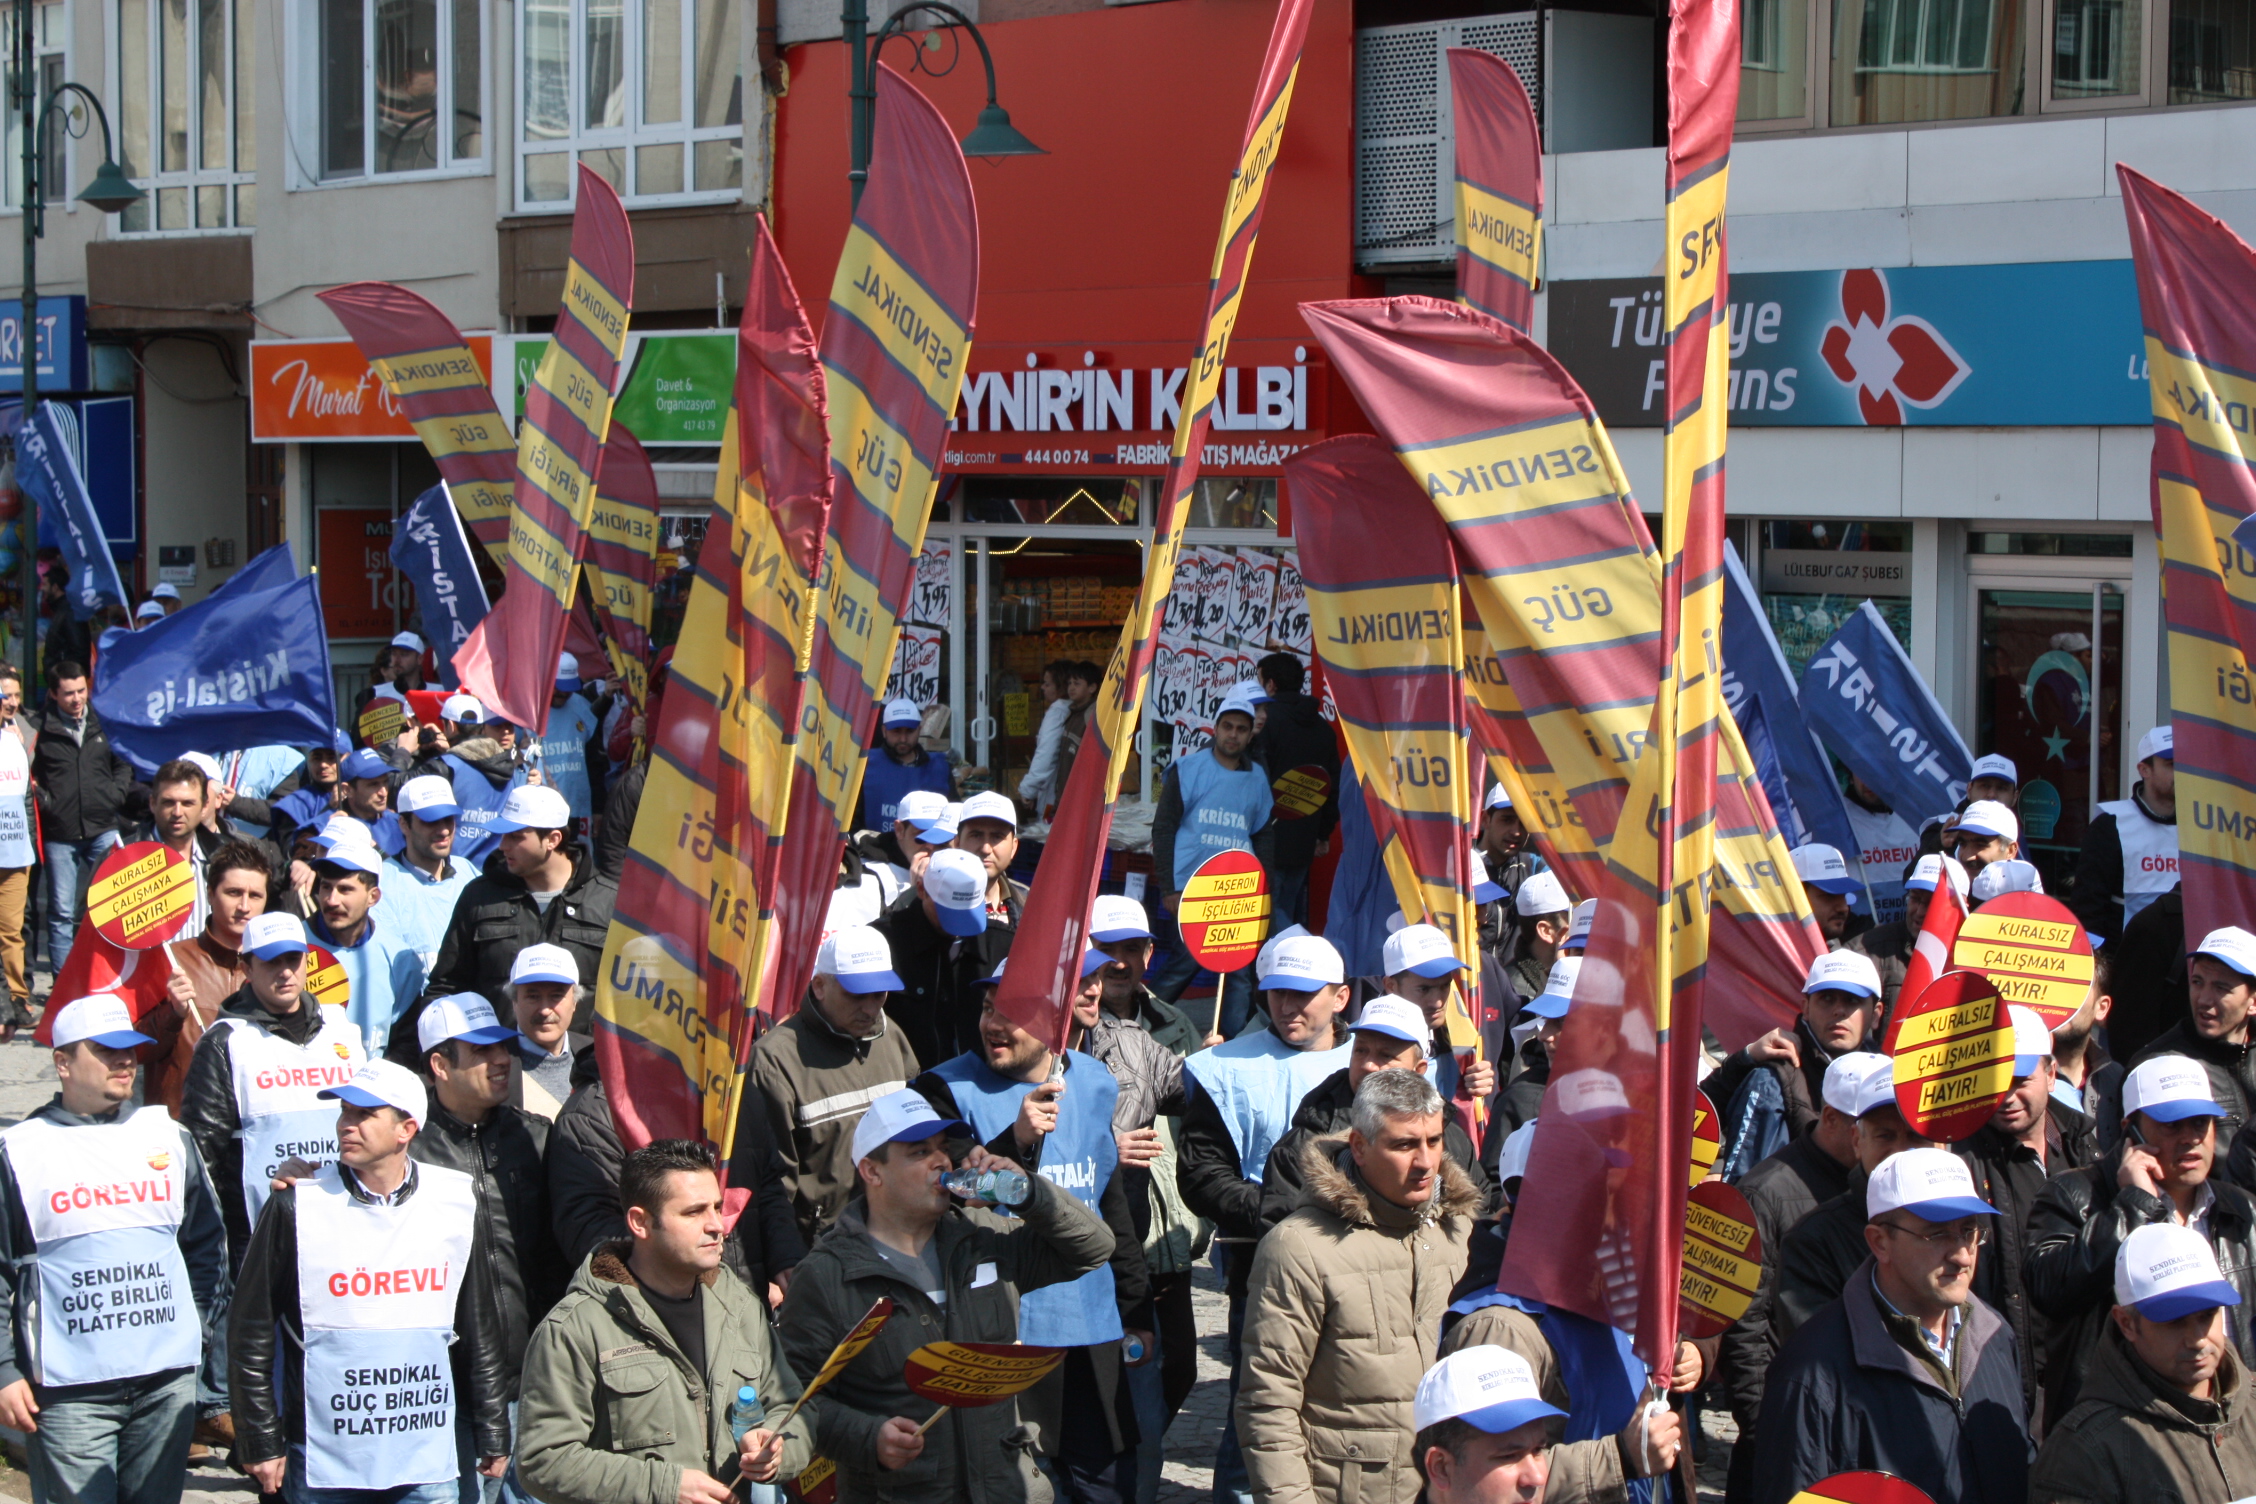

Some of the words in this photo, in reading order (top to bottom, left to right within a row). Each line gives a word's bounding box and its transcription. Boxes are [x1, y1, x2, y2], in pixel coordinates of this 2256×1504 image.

[656, 378, 683, 392] Davet
[685, 377, 693, 392] &
[950, 350, 1134, 432] YNİR'İN
[656, 396, 716, 414] Organizasyon
[683, 420, 696, 430] 417
[697, 420, 706, 430] 43
[707, 420, 716, 430] 79
[944, 450, 997, 465] tligi.com.tr
[1024, 450, 1053, 465] 444
[1053, 450, 1072, 465] 00
[1073, 450, 1090, 465] 74
[1117, 440, 1173, 466] FABRİK
[1199, 444, 1228, 470] ATIŞ
[1862, 564, 1903, 583] ŞUBESİ
[1198, 805, 1248, 831] KRİSTA
[112, 853, 164, 890] KURALSIZ
[112, 874, 172, 915] ÇALIŞMAYA
[1213, 876, 1257, 895] TAŞERON
[125, 898, 169, 932] HAYIR!
[1202, 899, 1257, 921] İŞÇİLİĞİNE
[1208, 926, 1242, 943] SON!
[1998, 922, 2070, 943] KURALSIZ
[1983, 949, 2066, 972] ÇALIŞMAYA
[1927, 1003, 1992, 1035] KURALSIZ
[1917, 1038, 1991, 1076] ÇALIŞMAYA
[1922, 1075, 1978, 1107] HAYIR!
[274, 1136, 342, 1159] SENDİKA
[50, 1173, 172, 1215] GÖREVLİ
[70, 1260, 166, 1290] SENDİKAL
[327, 1261, 449, 1298] GÖREVLİ
[61, 1284, 106, 1315] GÜÇ
[110, 1280, 174, 1309] BİRLİĞİ
[66, 1304, 177, 1337] PLATFORMU
[343, 1362, 442, 1387] SENDİKAL
[931, 1377, 1004, 1395] HAYIR!
[330, 1392, 377, 1417] GÜÇ
[384, 1383, 449, 1409] BİRLİĞİ
[332, 1410, 447, 1436] PLATFORMU
